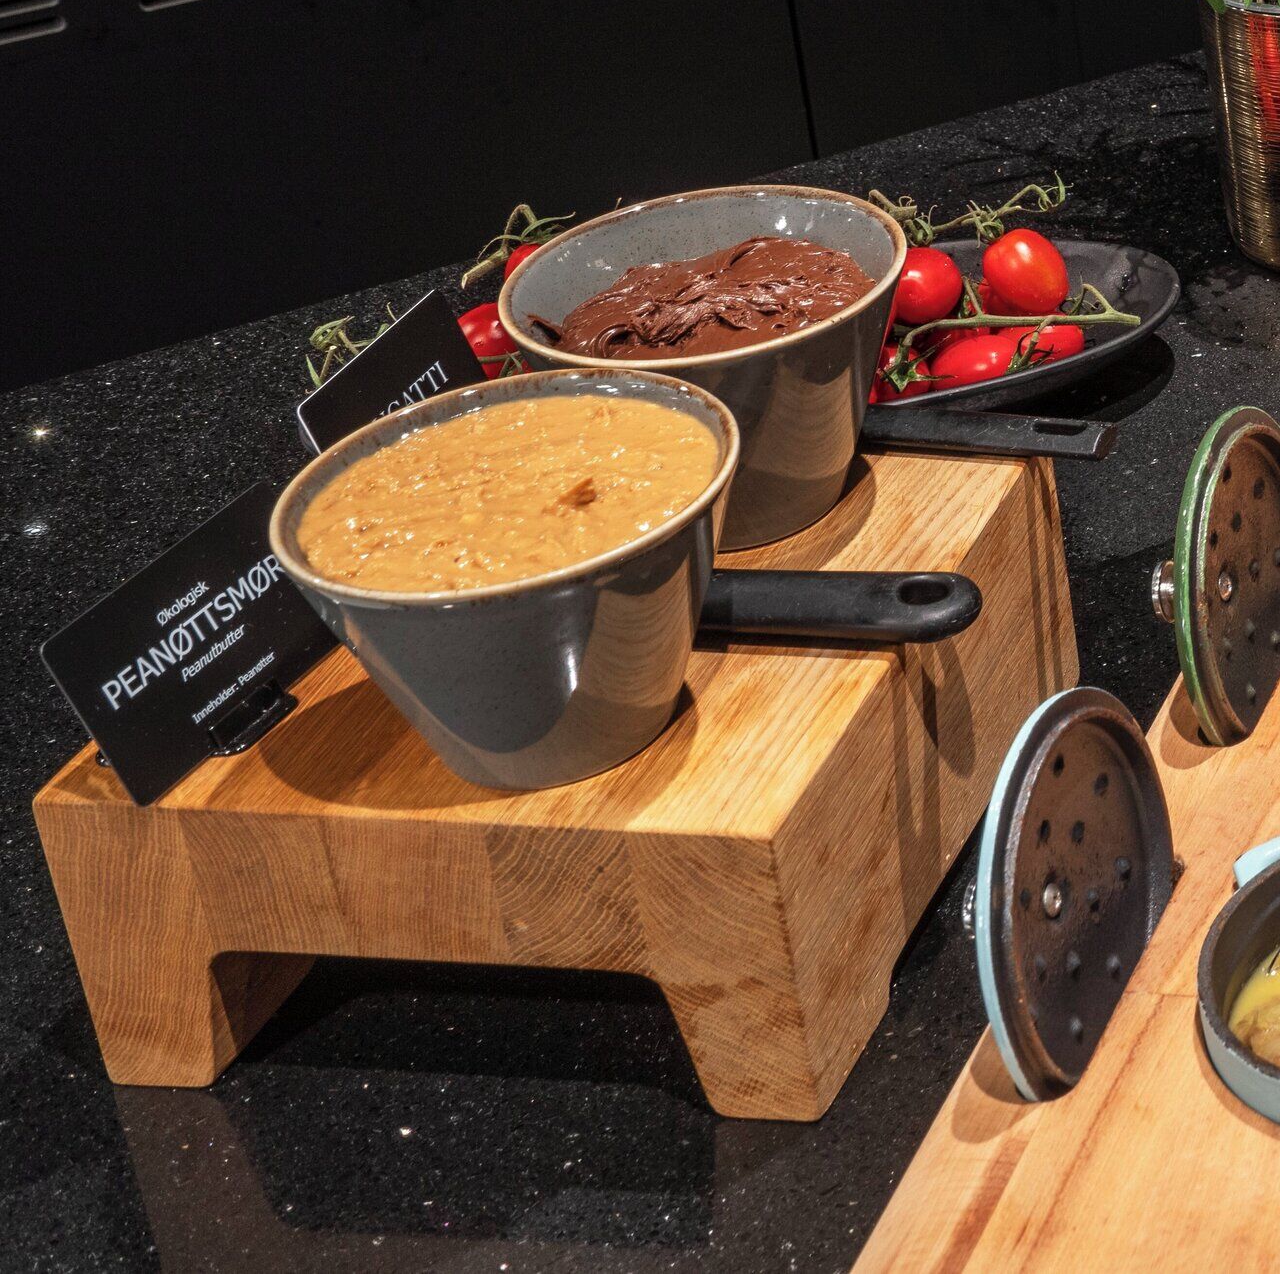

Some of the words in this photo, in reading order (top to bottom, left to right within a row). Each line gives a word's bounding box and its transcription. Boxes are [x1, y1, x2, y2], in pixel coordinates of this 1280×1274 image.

[101, 553, 286, 711] PEANØTTSMØR
[156, 580, 210, 626] Økologisk
[181, 624, 246, 683] Peanutbutter
[191, 682, 239, 725] Inneholder:
[237, 651, 276, 686] Peanøtter
